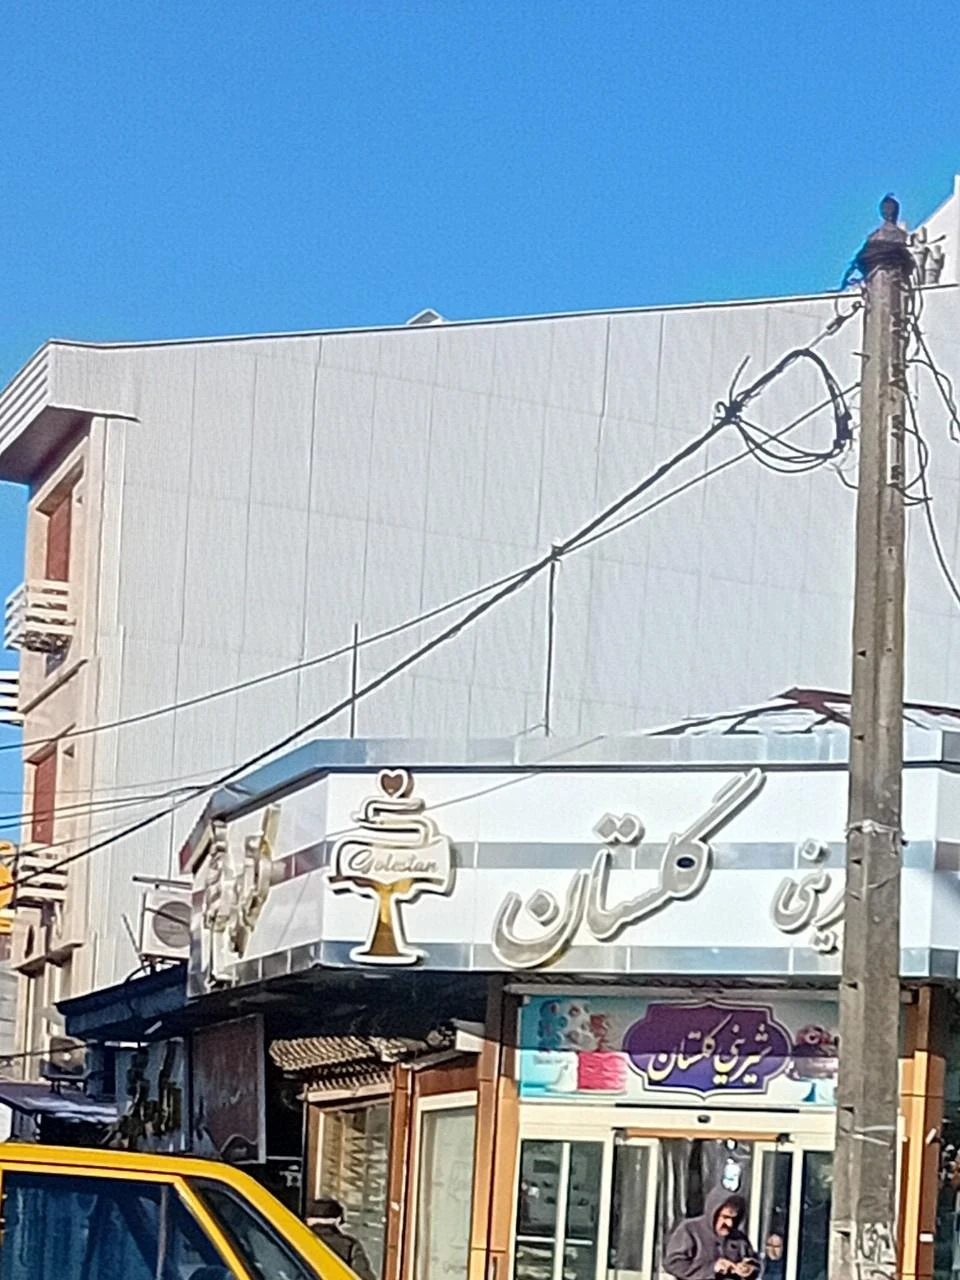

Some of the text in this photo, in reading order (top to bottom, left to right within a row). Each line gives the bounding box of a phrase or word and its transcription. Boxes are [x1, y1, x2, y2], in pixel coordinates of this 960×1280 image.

[347, 849, 439, 875] Golestan
[490, 769, 766, 969] گلستان
[646, 1012, 773, 1085] شیرینی گلستان
